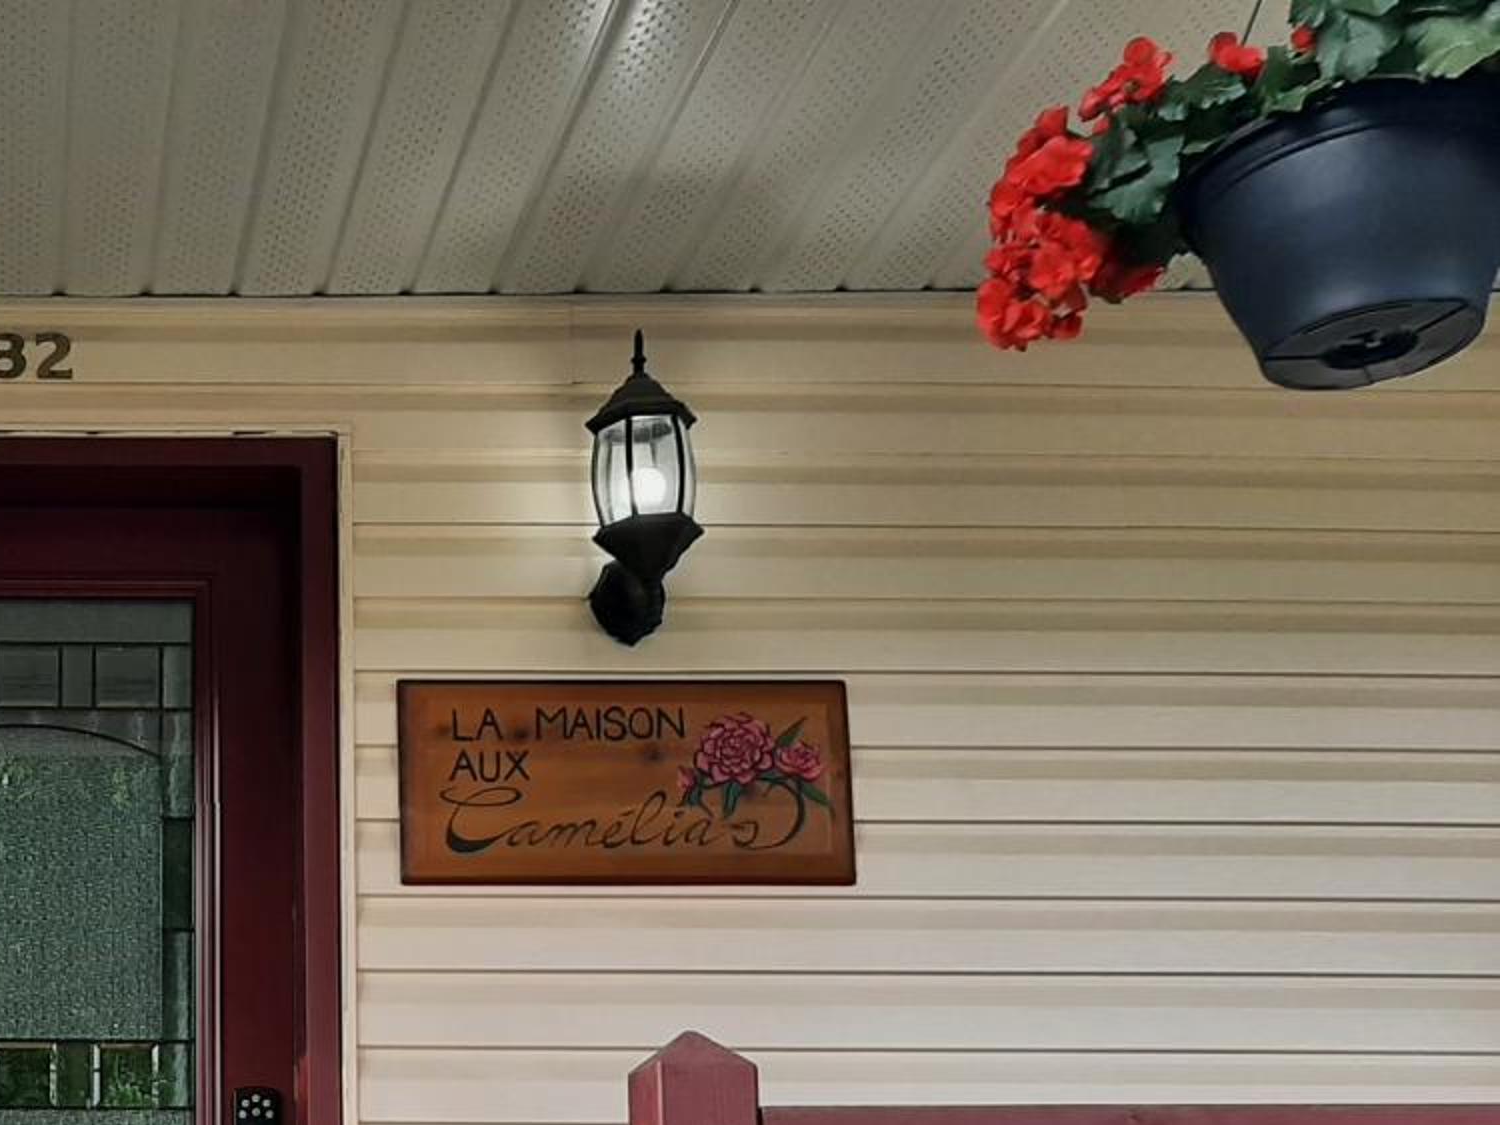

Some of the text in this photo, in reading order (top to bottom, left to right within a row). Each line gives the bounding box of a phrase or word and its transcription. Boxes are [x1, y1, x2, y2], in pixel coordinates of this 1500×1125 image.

[450, 706, 686, 743] LA MAISON
[448, 749, 531, 782] AUX
